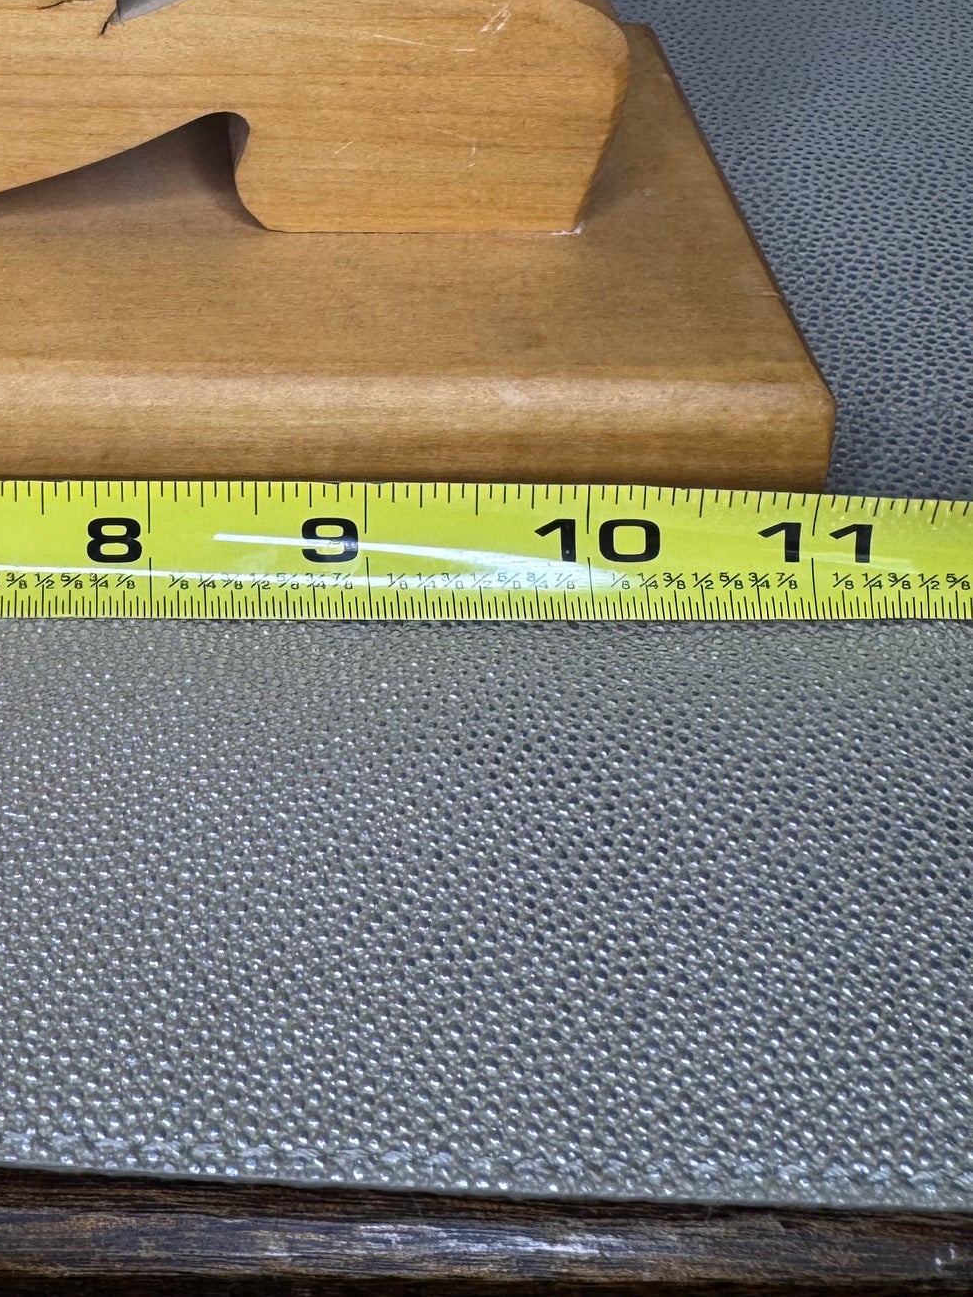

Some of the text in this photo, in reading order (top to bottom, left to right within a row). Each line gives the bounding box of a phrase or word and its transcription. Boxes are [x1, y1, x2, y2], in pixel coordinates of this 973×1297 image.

[86, 517, 143, 563] 8
[301, 517, 359, 563] 9
[534, 518, 661, 563] 10
[758, 521, 873, 563] 11
[6, 572, 28, 589] 3/8
[34, 573, 55, 589] 1/2
[61, 573, 83, 589] 5/8
[89, 573, 109, 589] 3/4
[115, 573, 135, 589] 7/8
[610, 572, 630, 589] 1/8
[637, 572, 659, 589] 1/4
[662, 572, 686, 590] 3/8
[692, 572, 715, 590] 1/2
[719, 572, 744, 590] 5/8
[748, 572, 771, 589] 3/4
[775, 573, 798, 590] 7/8
[832, 572, 854, 590] 1/8
[862, 572, 883, 590] 1/4
[887, 572, 911, 590] 3/8
[918, 573, 940, 590] 1/2
[945, 573, 971, 590] 5/8
